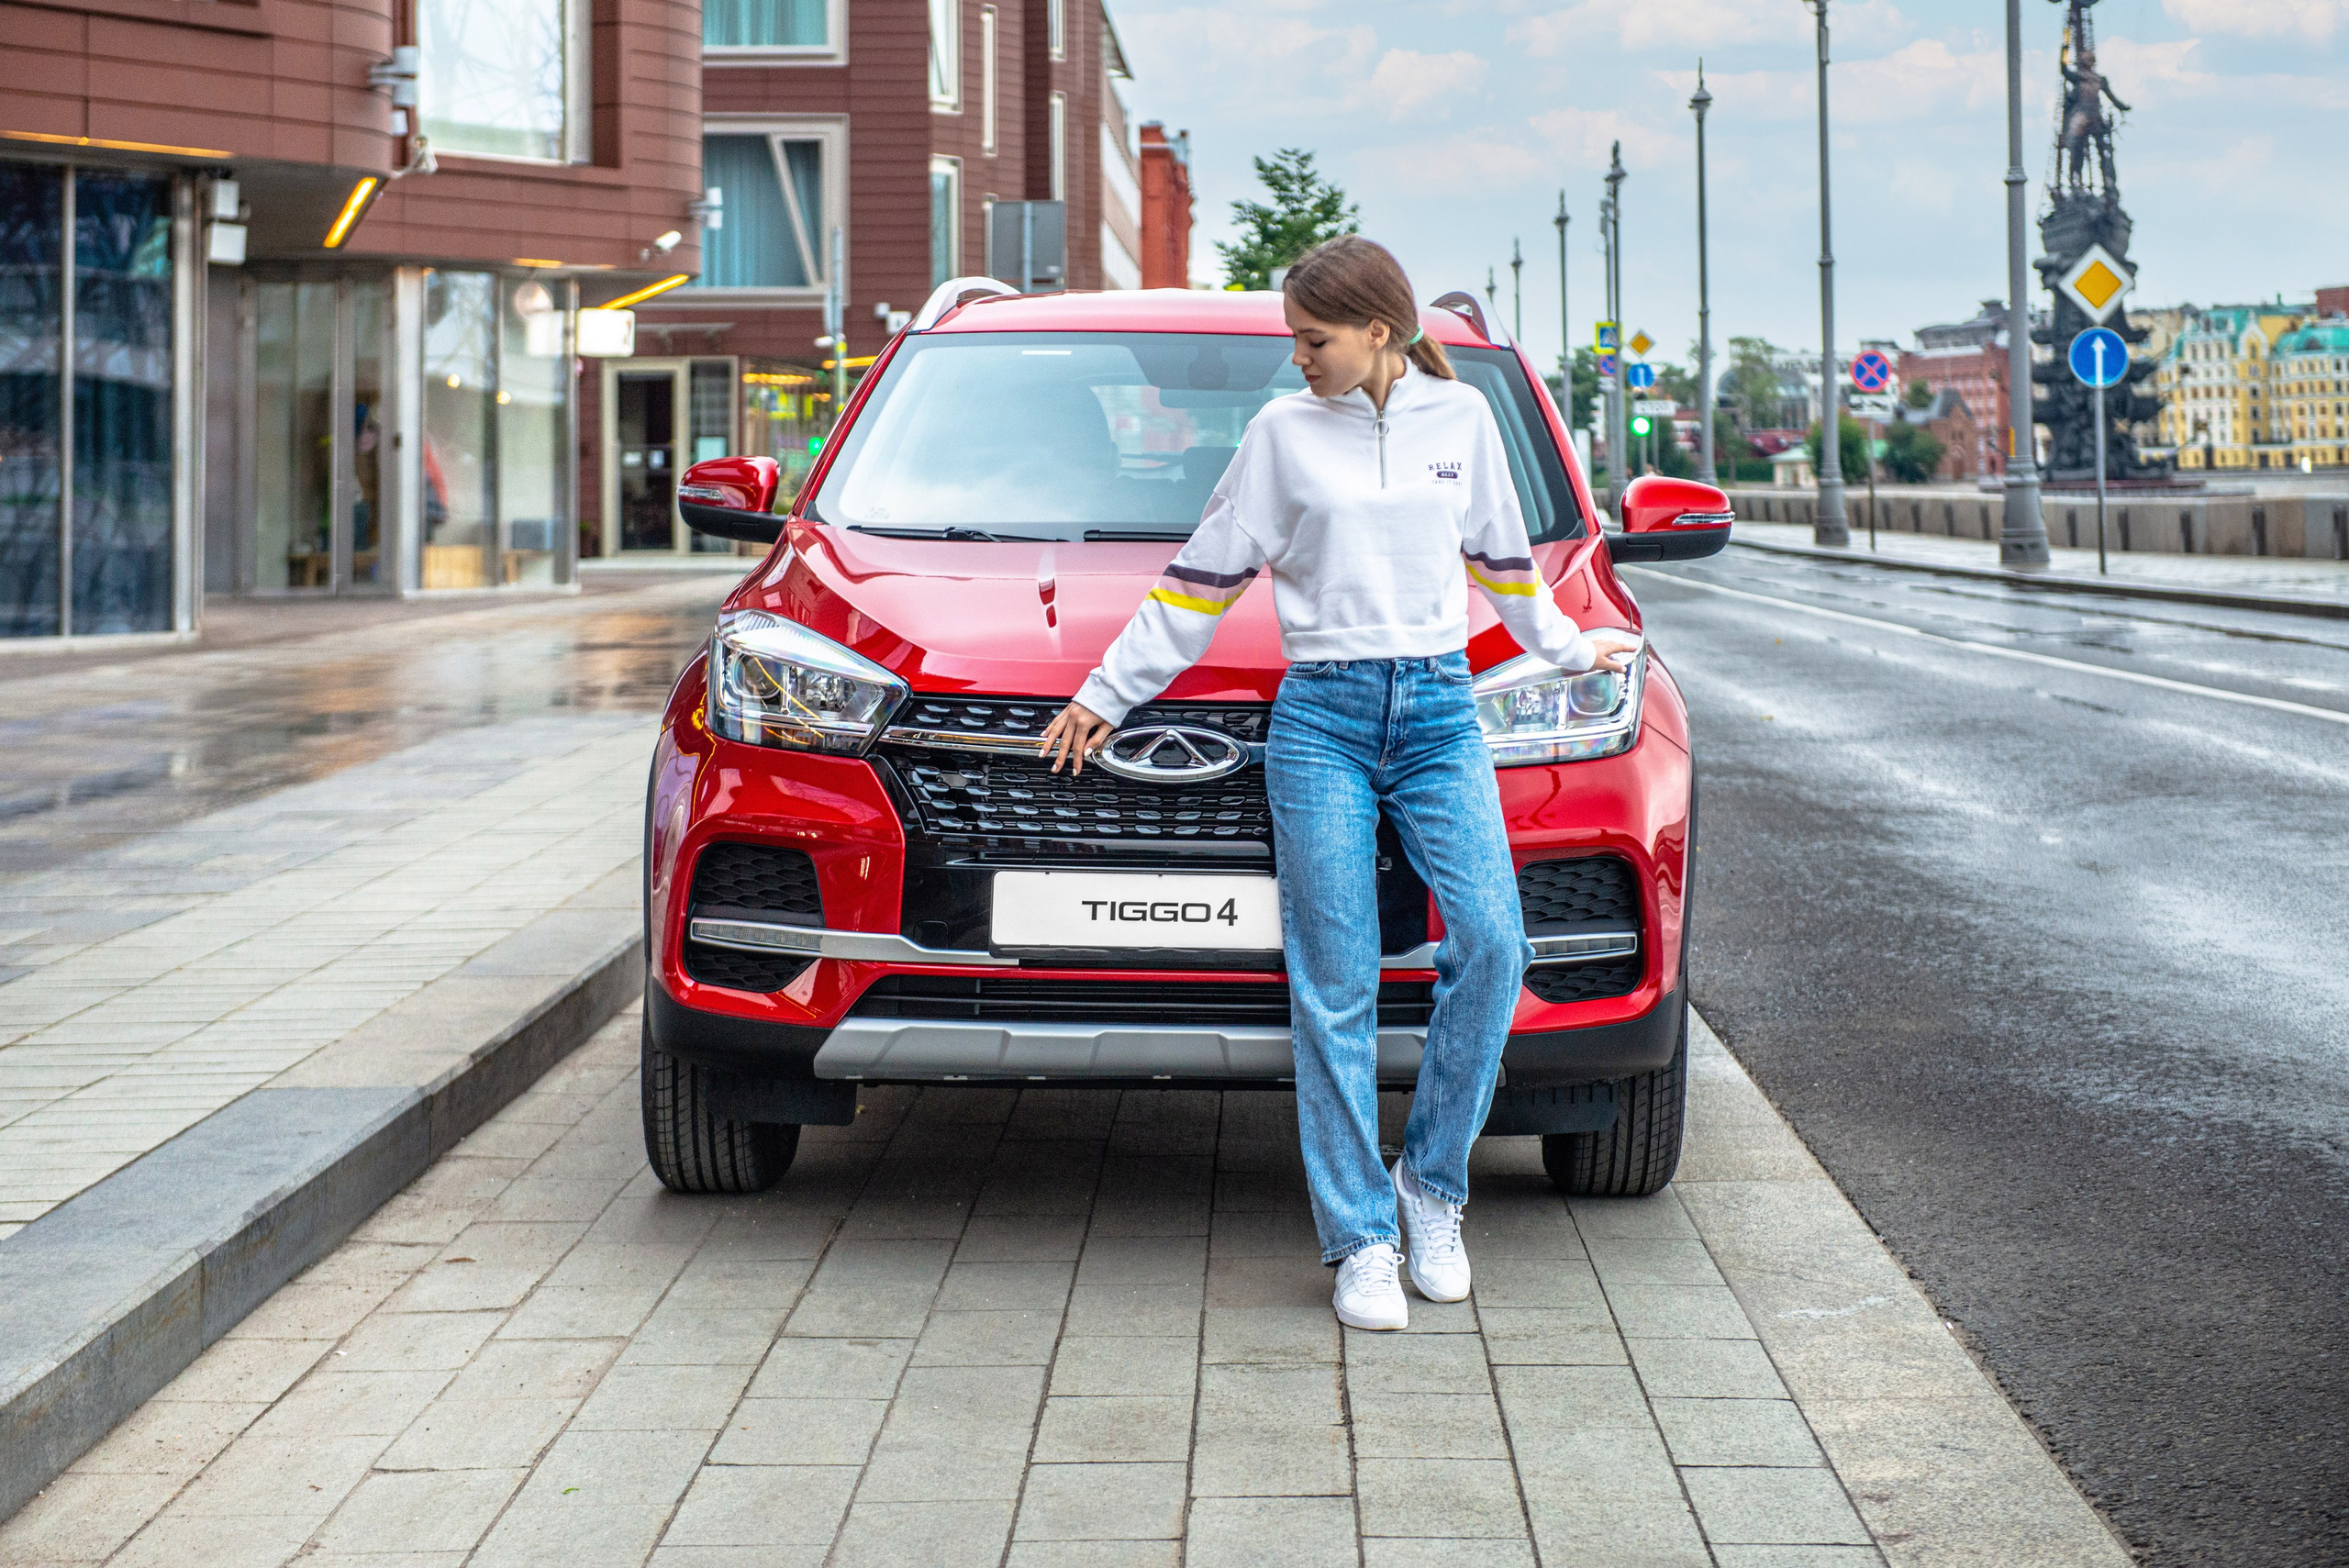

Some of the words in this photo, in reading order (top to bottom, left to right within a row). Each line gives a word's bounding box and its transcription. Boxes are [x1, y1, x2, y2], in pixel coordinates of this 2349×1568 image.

[1428, 462, 1462, 471] RELAX
[1081, 900, 1211, 923] TIGGO
[1217, 897, 1239, 927] 4
